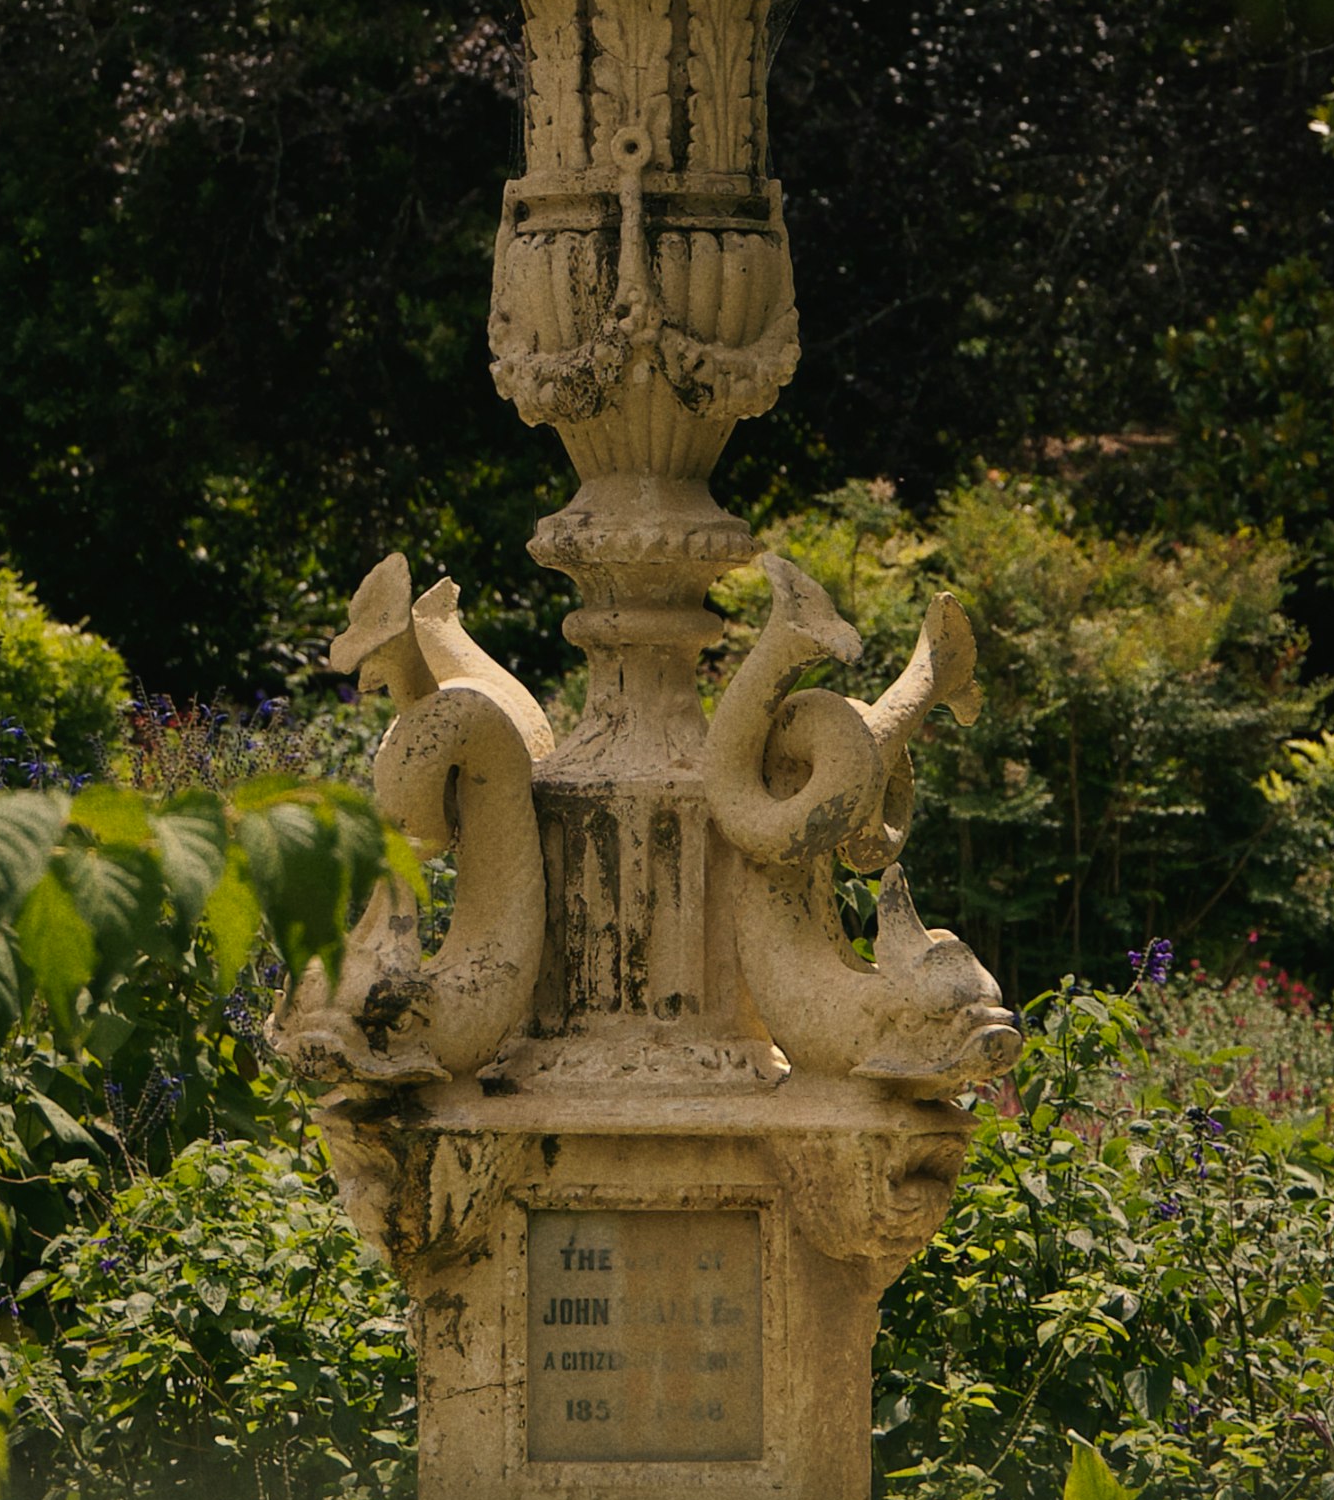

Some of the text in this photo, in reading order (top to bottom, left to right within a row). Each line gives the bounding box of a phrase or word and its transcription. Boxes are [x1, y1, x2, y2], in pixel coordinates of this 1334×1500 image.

[560, 1248, 613, 1271] THE
[543, 1297, 609, 1326] JOHN
[543, 1351, 556, 1371] A
[565, 1399, 623, 1422] 185
